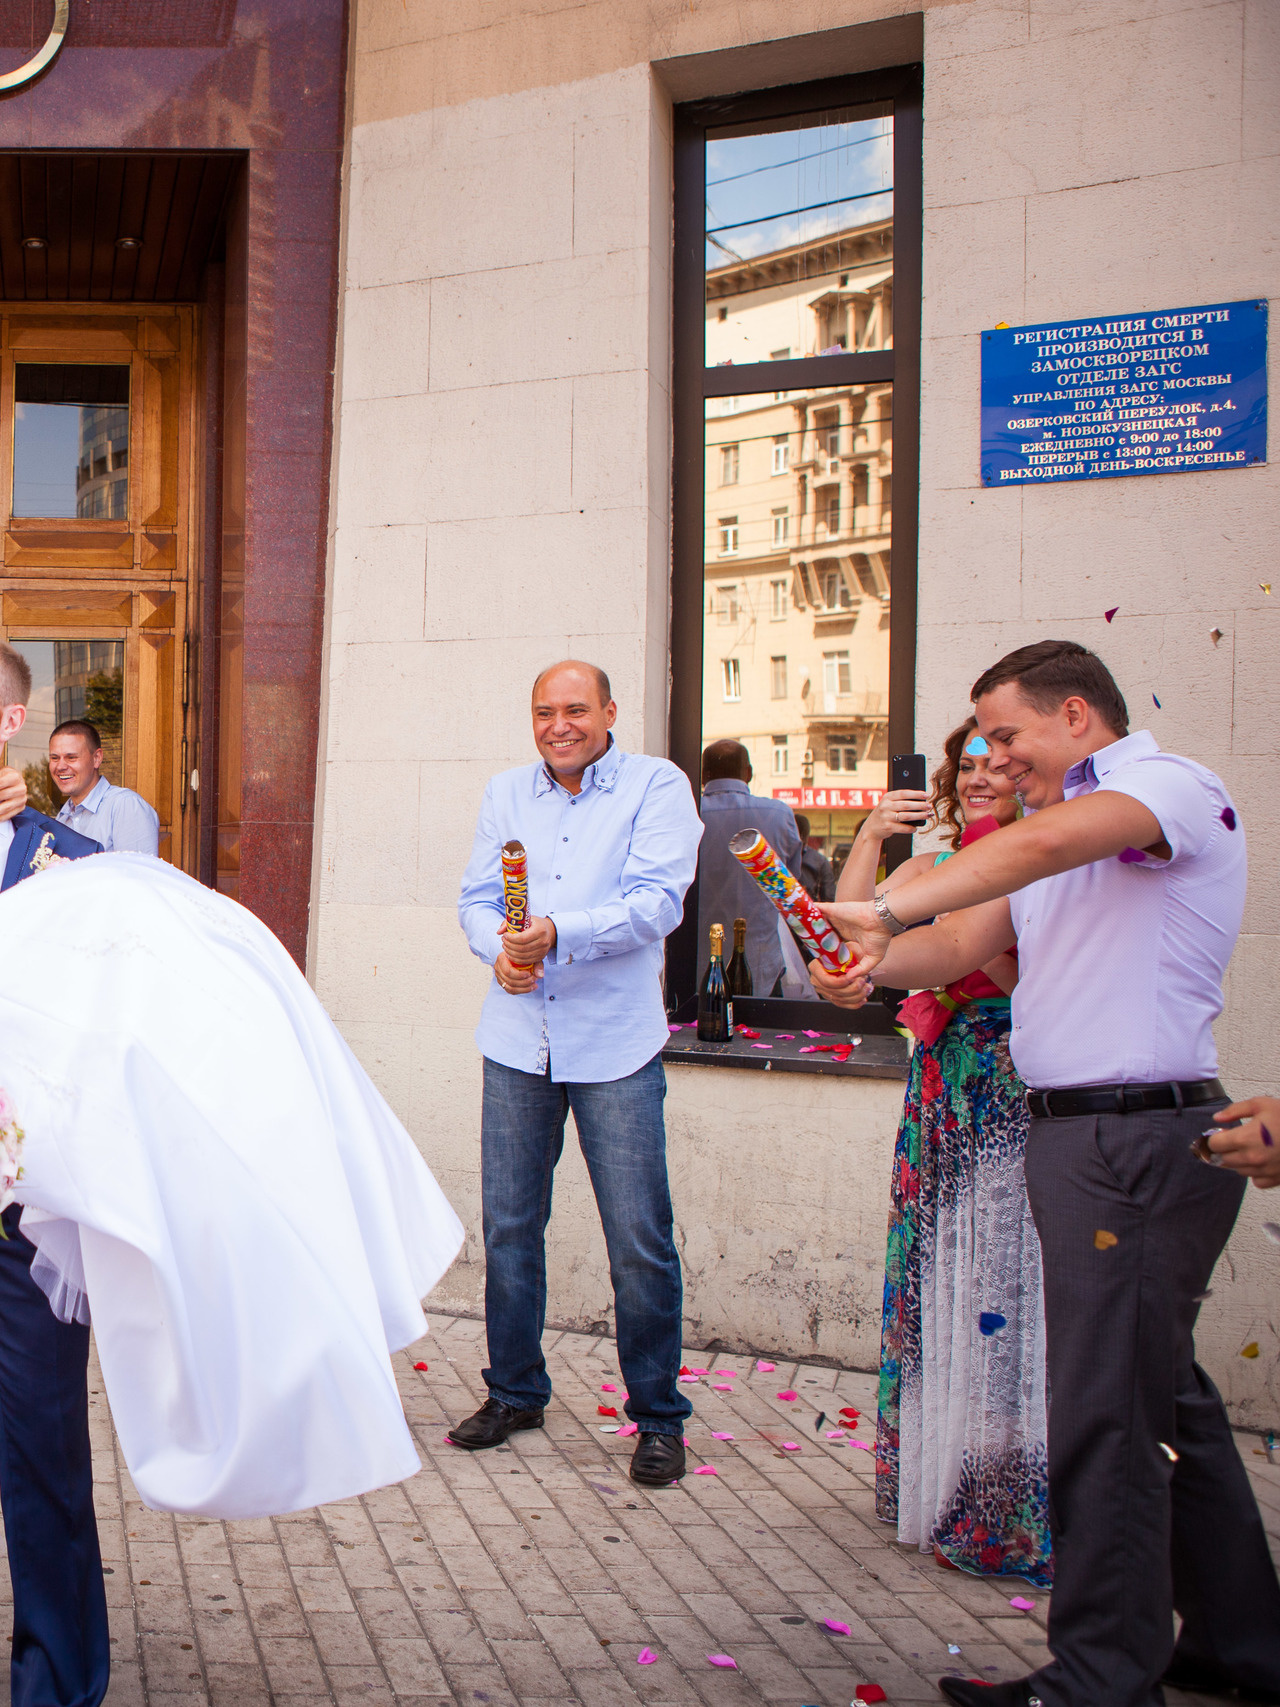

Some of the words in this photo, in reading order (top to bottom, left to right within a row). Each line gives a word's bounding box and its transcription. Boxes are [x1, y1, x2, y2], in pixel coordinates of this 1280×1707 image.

[1013, 319, 1146, 345] РЕГИСТРАЦИЯ
[1152, 310, 1230, 329] СМЕРТИ
[1037, 330, 1185, 357] ПРОИЗВОДИТСЯ
[1191, 328, 1204, 340] В
[1031, 344, 1210, 373] ЗАМОСКВОРЕЦКОМ
[1056, 368, 1129, 386] ОТДЕЛЕ
[1134, 362, 1182, 378] ЗАГС
[1013, 385, 1116, 404] УПРАВЛЕНИЯ
[1120, 381, 1158, 394] ЗАГС
[1162, 374, 1232, 390] МОСКВЫ
[1074, 400, 1096, 411] ПО
[1100, 394, 1164, 410] АДРЕСУ:
[1007, 409, 1114, 430] ОЗЕРКОВСКИЙ
[1118, 402, 1206, 420] ПЕРЕУЛОК,
[1210, 399, 1236, 412] д.4,
[1042, 431, 1056, 439] м.
[1061, 416, 1197, 438] НОВОКУЗНЕЦКАЯ
[1021, 436, 1115, 454] ЕЖЕДНЕВНО
[1130, 432, 1160, 444] 9:00
[1162, 433, 1180, 442] до
[1184, 426, 1222, 439] 18:00
[1028, 450, 1099, 465] ПЕРЕРЫВ
[1115, 446, 1151, 458] 13:00
[1154, 446, 1171, 456] до
[1176, 440, 1214, 453] 14:00
[1000, 462, 1085, 480] ВЫХОДНОЙ
[1089, 450, 1246, 474] ДЕНЬ-ВОСКРЕСЕНЬЕ
